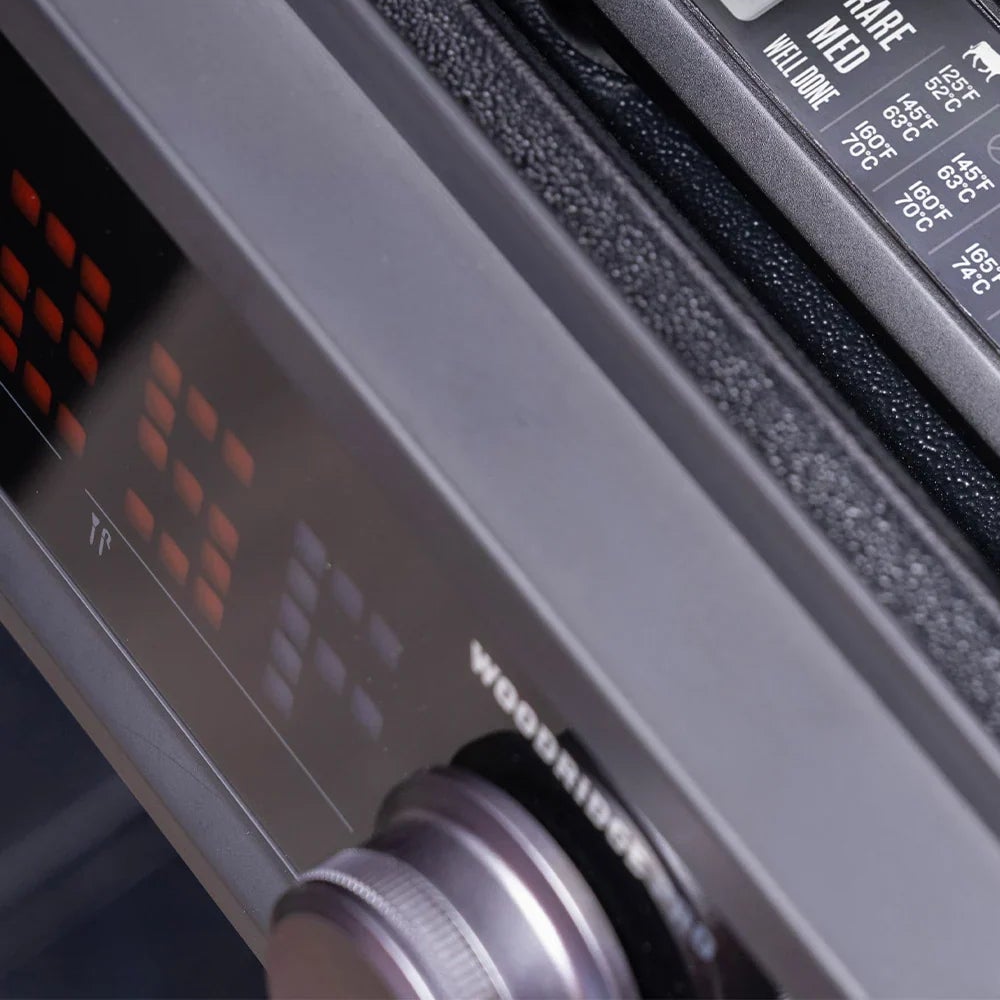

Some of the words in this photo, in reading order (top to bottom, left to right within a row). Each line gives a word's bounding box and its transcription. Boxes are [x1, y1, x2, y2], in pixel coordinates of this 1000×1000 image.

[806, 15, 871, 74] MED
[762, 32, 809, 78] WELL
[789, 64, 841, 112] DONE
[938, 64, 981, 100] 125°F
[896, 92, 939, 130] 145°F
[924, 76, 962, 113] 52°C
[854, 120, 898, 159] 160°F
[882, 105, 921, 142] 63°C
[841, 131, 879, 171] 70°C
[937, 165, 977, 204] 63°C
[950, 152, 996, 191] 145°F
[894, 191, 934, 233] 70°C
[908, 180, 954, 220] 160°F
[951, 255, 991, 295] 74°C
